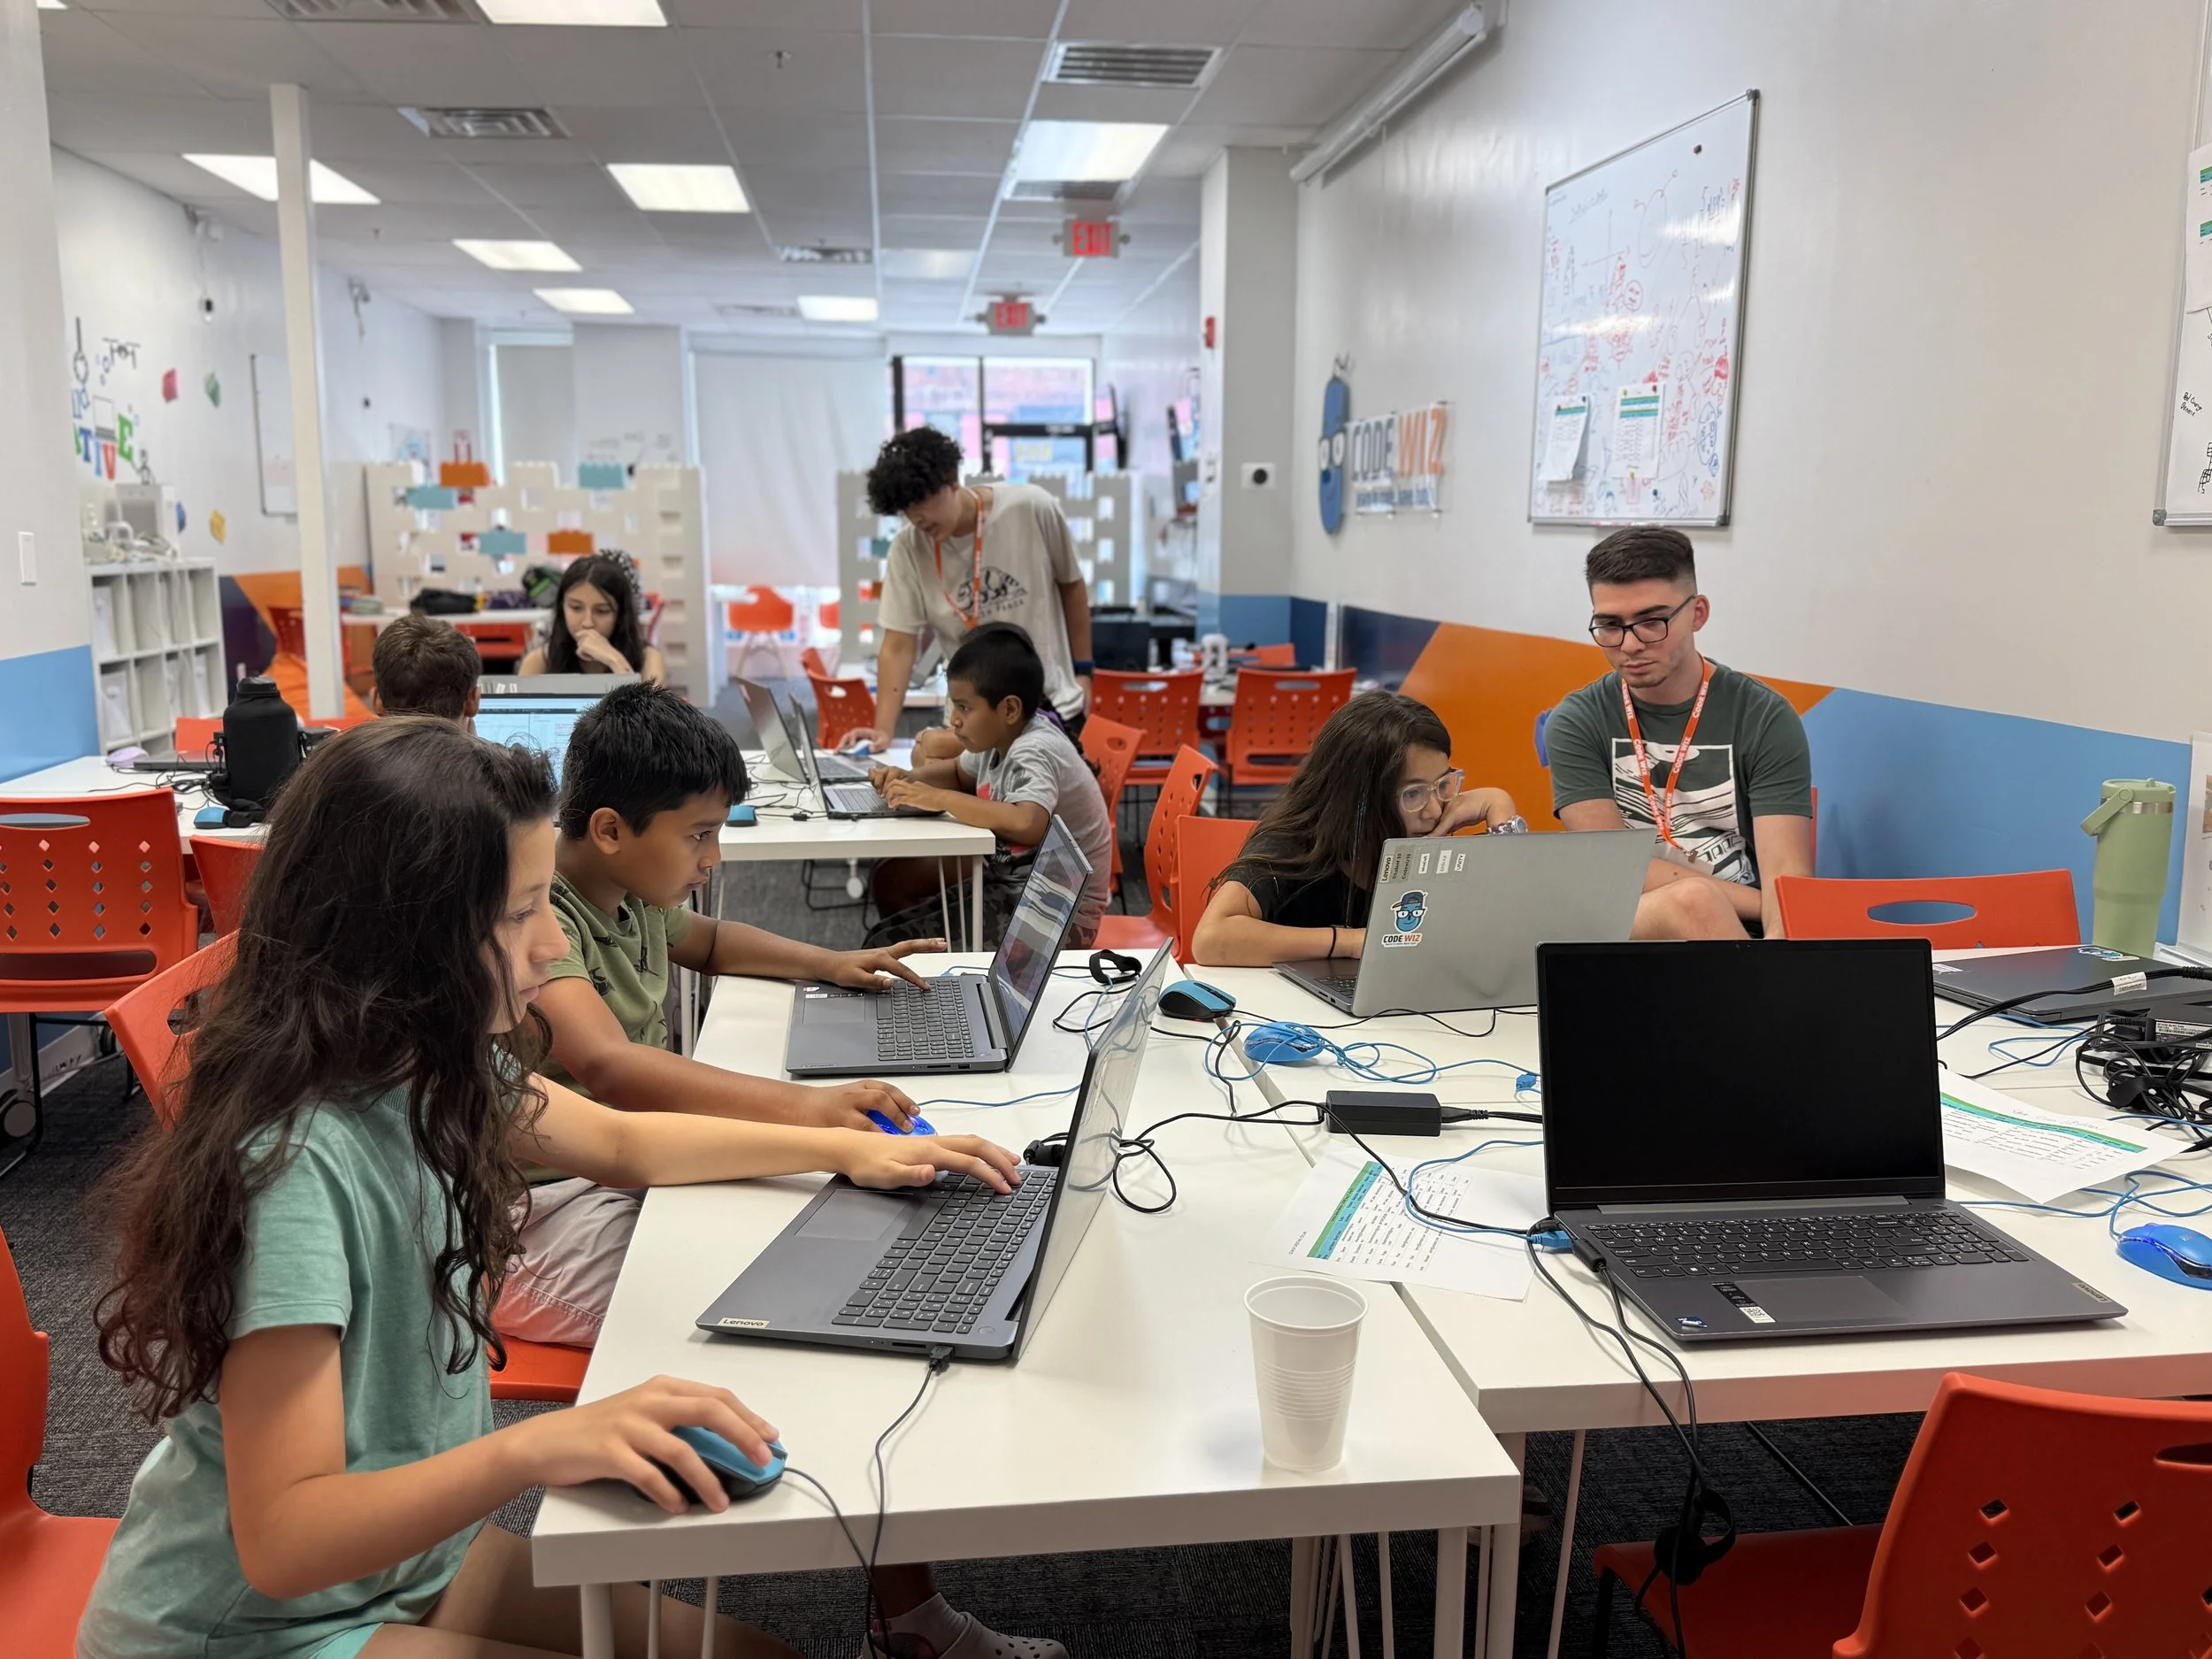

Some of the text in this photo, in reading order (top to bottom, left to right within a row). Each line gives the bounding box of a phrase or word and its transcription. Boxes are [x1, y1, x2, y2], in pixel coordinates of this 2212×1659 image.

[1073, 222, 1112, 257] EXIT
[995, 303, 1028, 328] EXIT
[1352, 408, 1444, 481] CODE WIZ
[1692, 696, 1704, 718] CODE
[1633, 739, 1644, 761] CODE
[1673, 736, 1692, 774] CODE WIZ
[1382, 856, 1391, 881] Lenovo
[1383, 934, 1403, 943] CODE
[2078, 1284, 2108, 1302] Lenovo
